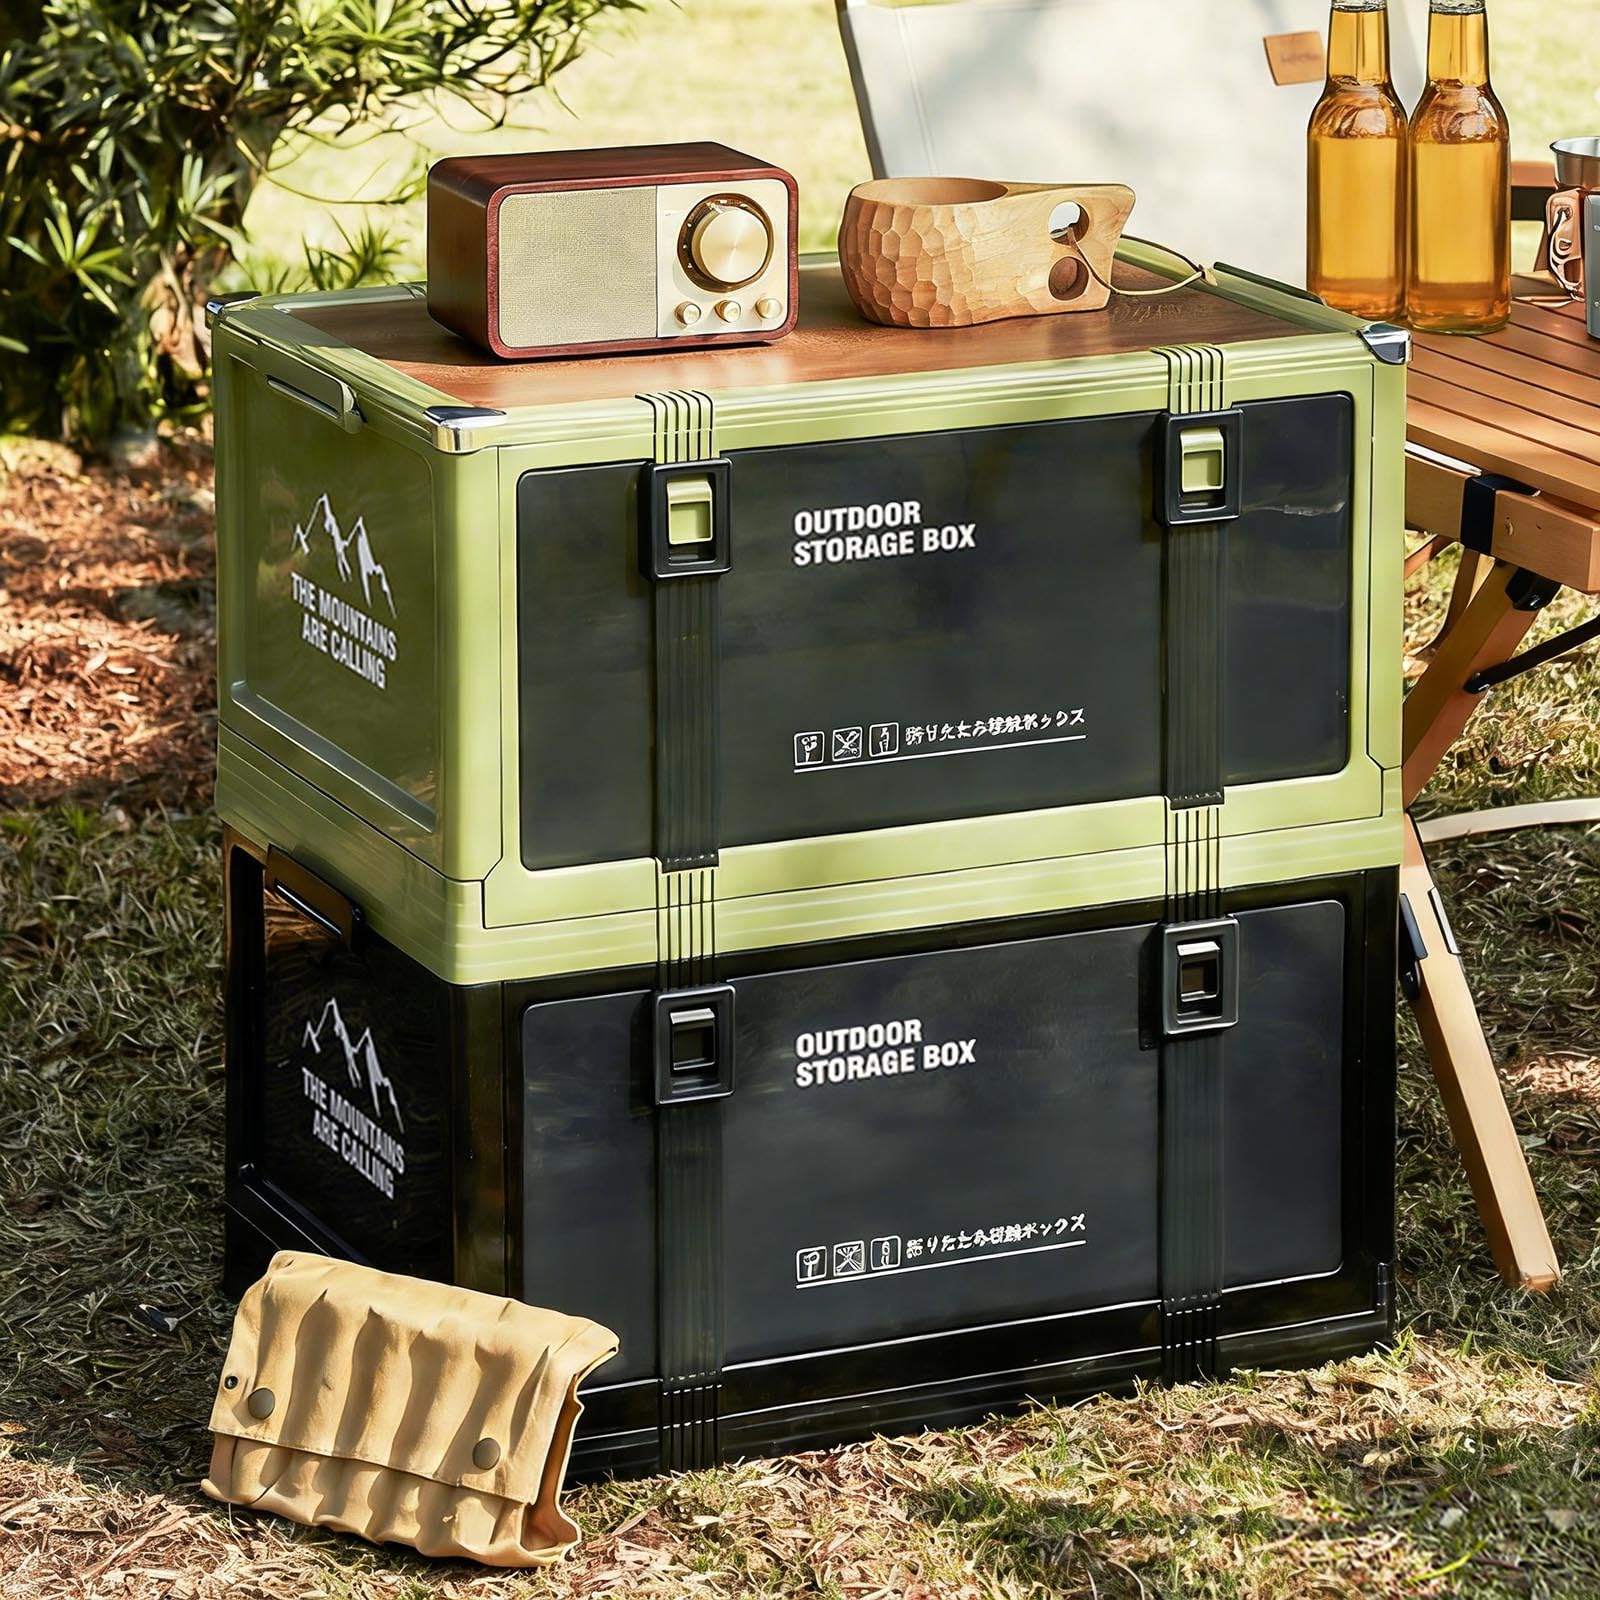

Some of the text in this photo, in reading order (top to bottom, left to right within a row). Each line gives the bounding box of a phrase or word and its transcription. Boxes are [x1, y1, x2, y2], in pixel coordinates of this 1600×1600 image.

[793, 524, 976, 566] STORAGE BOX
[794, 501, 921, 536] OUTDOOR
[291, 571, 397, 661] THE MOUNTAINS
[302, 613, 385, 690] ARE CALLING
[796, 1019, 922, 1058] OUTDOOR
[796, 1039, 976, 1087] STORAGE BOX
[302, 1067, 405, 1175] THE MOUNTAINS
[313, 1110, 394, 1200] ARE CALLING
